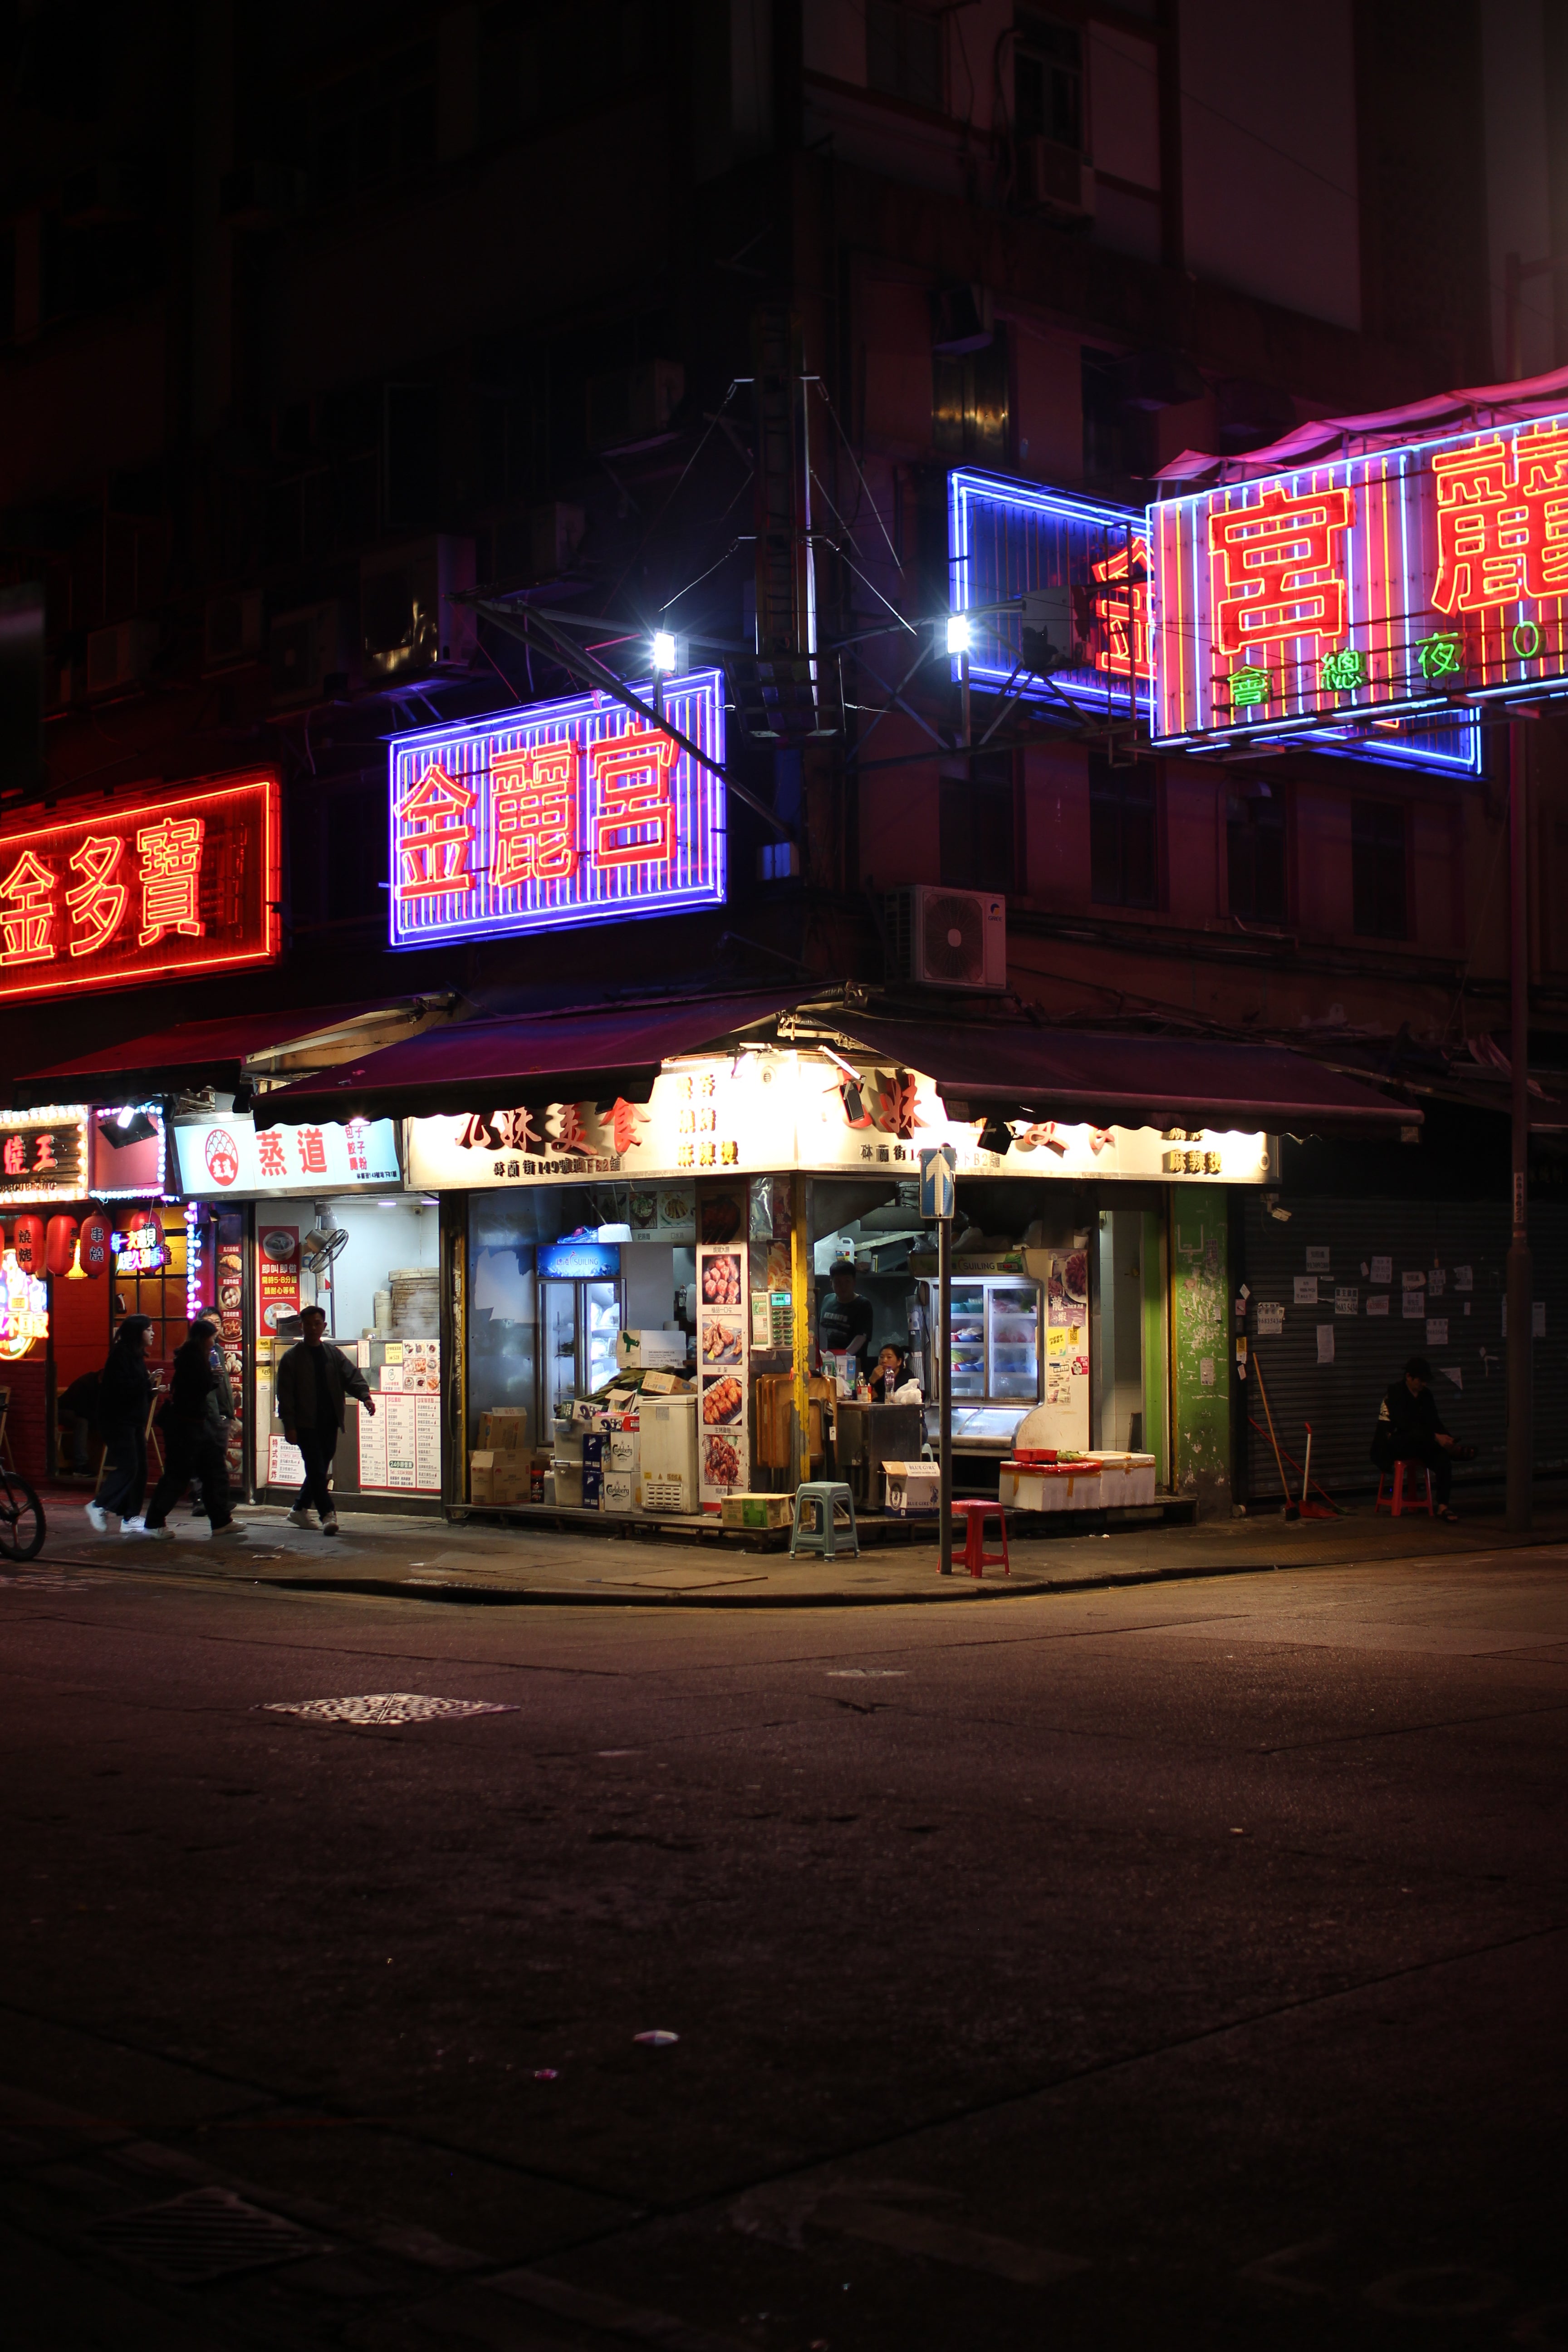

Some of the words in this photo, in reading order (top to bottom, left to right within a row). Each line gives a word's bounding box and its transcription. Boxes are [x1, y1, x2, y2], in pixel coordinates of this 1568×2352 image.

[394, 720, 680, 900] 金麗宮
[0, 818, 205, 966] 金多寶
[345, 1126, 363, 1139] 包子
[256, 1128, 328, 1176] 蒸道
[347, 1141, 365, 1155] 餃子
[677, 1141, 739, 1167] 麻辣燙
[1169, 1149, 1222, 1175] 麻辣燙
[19, 1230, 32, 1262] 燒烤
[89, 1227, 104, 1262] 串燒
[261, 1264, 297, 1274] 即叫即做
[264, 1286, 295, 1295] 請耐心等候
[612, 1444, 633, 1455] Carlsberg
[606, 1484, 629, 1494] Carlsberg
